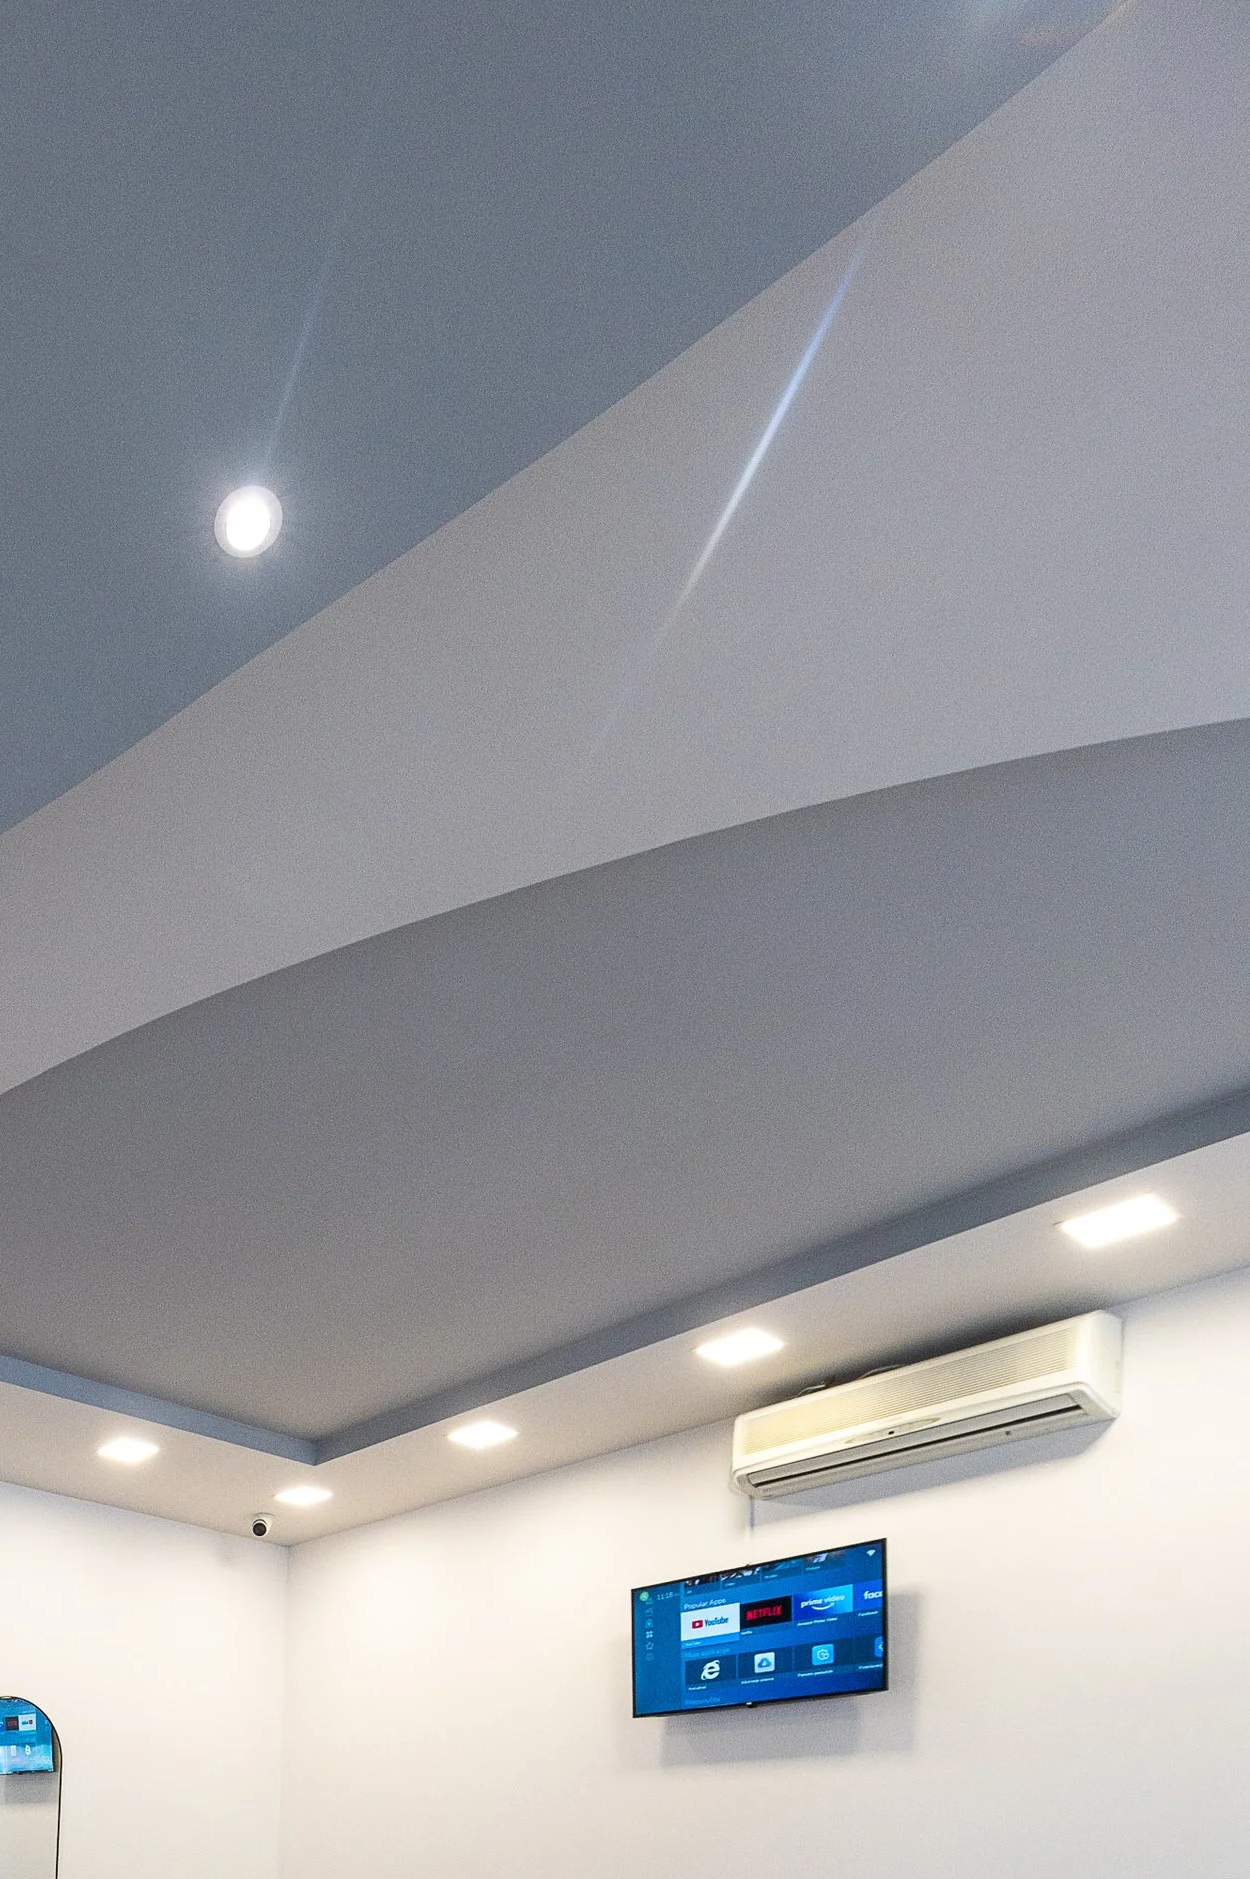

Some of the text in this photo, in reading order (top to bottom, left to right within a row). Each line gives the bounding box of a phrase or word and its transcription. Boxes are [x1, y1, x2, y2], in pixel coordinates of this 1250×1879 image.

[683, 1598, 727, 1610] Popular Apps
[800, 1594, 845, 1608] prime video
[746, 1605, 782, 1621] NETFLIX
[704, 1616, 729, 1627] YouTube
